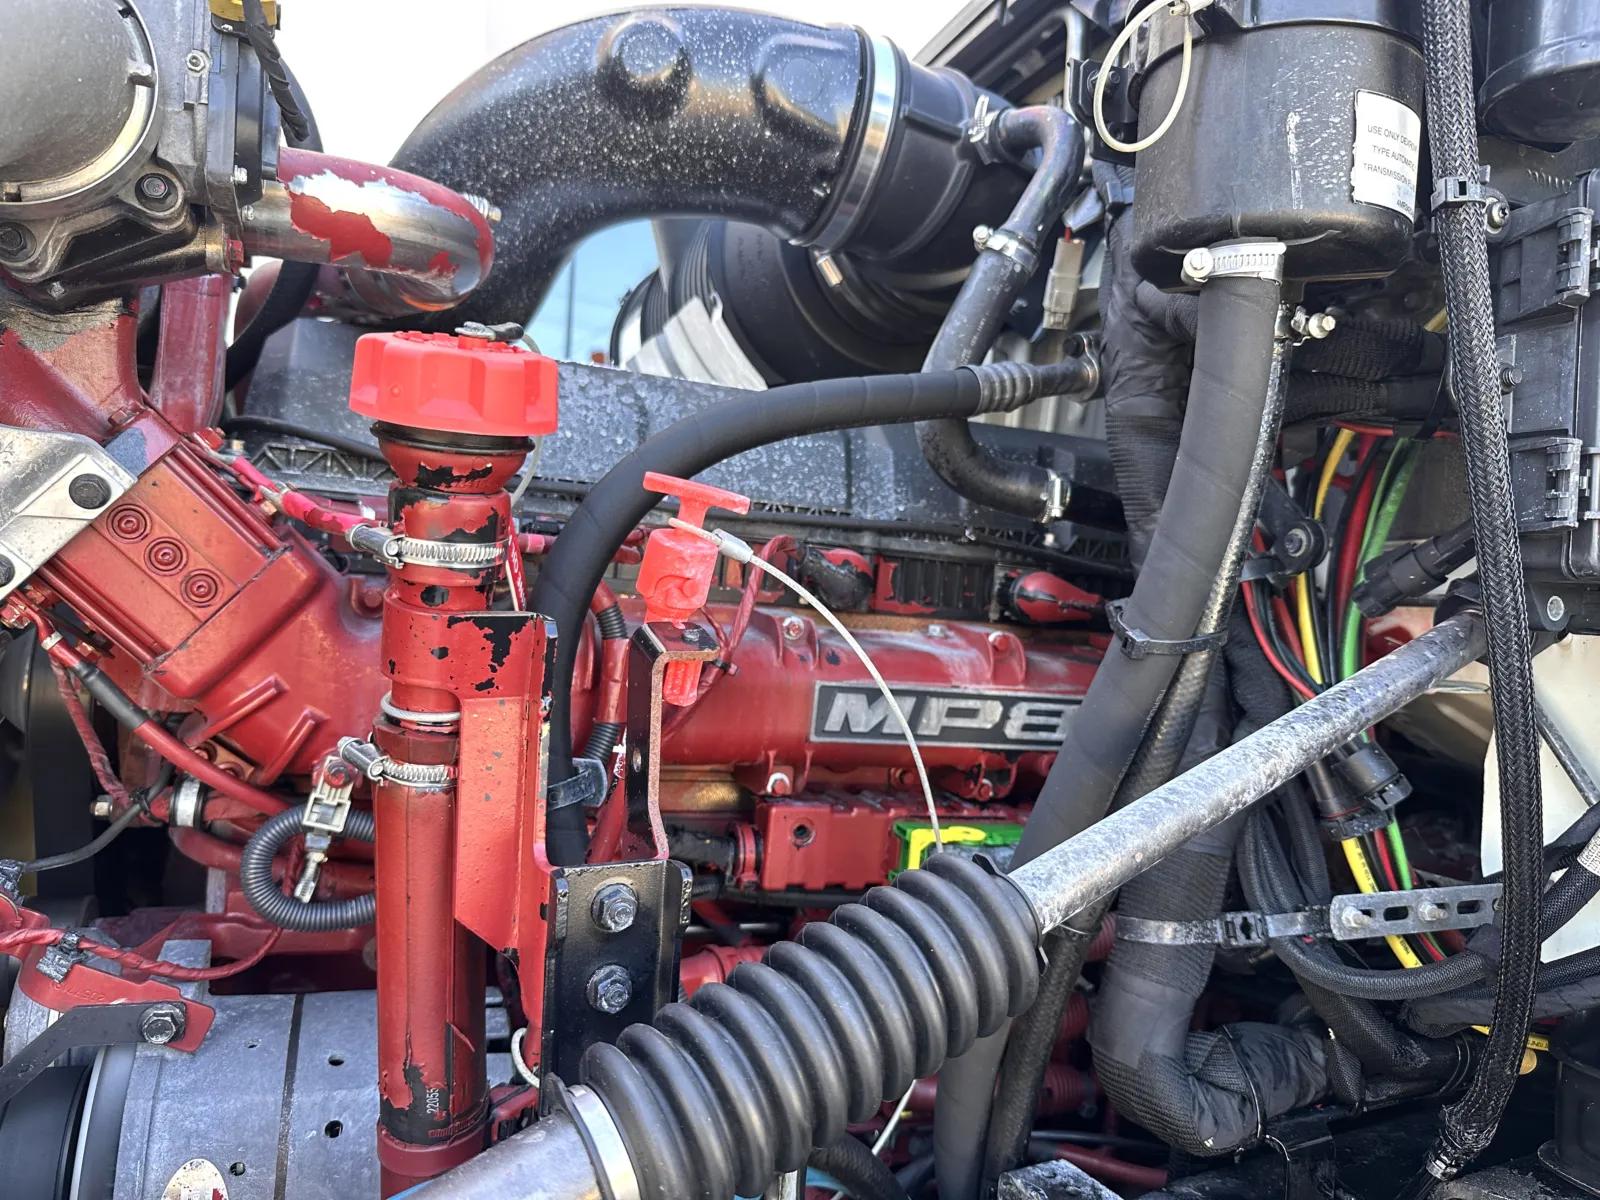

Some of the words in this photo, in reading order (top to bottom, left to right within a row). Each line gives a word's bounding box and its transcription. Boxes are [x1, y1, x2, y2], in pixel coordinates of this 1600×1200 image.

[1367, 124, 1383, 136] USE
[1384, 128, 1400, 141] ONLY
[1372, 144, 1390, 158] TYPE
[823, 692, 1081, 739] MP8
